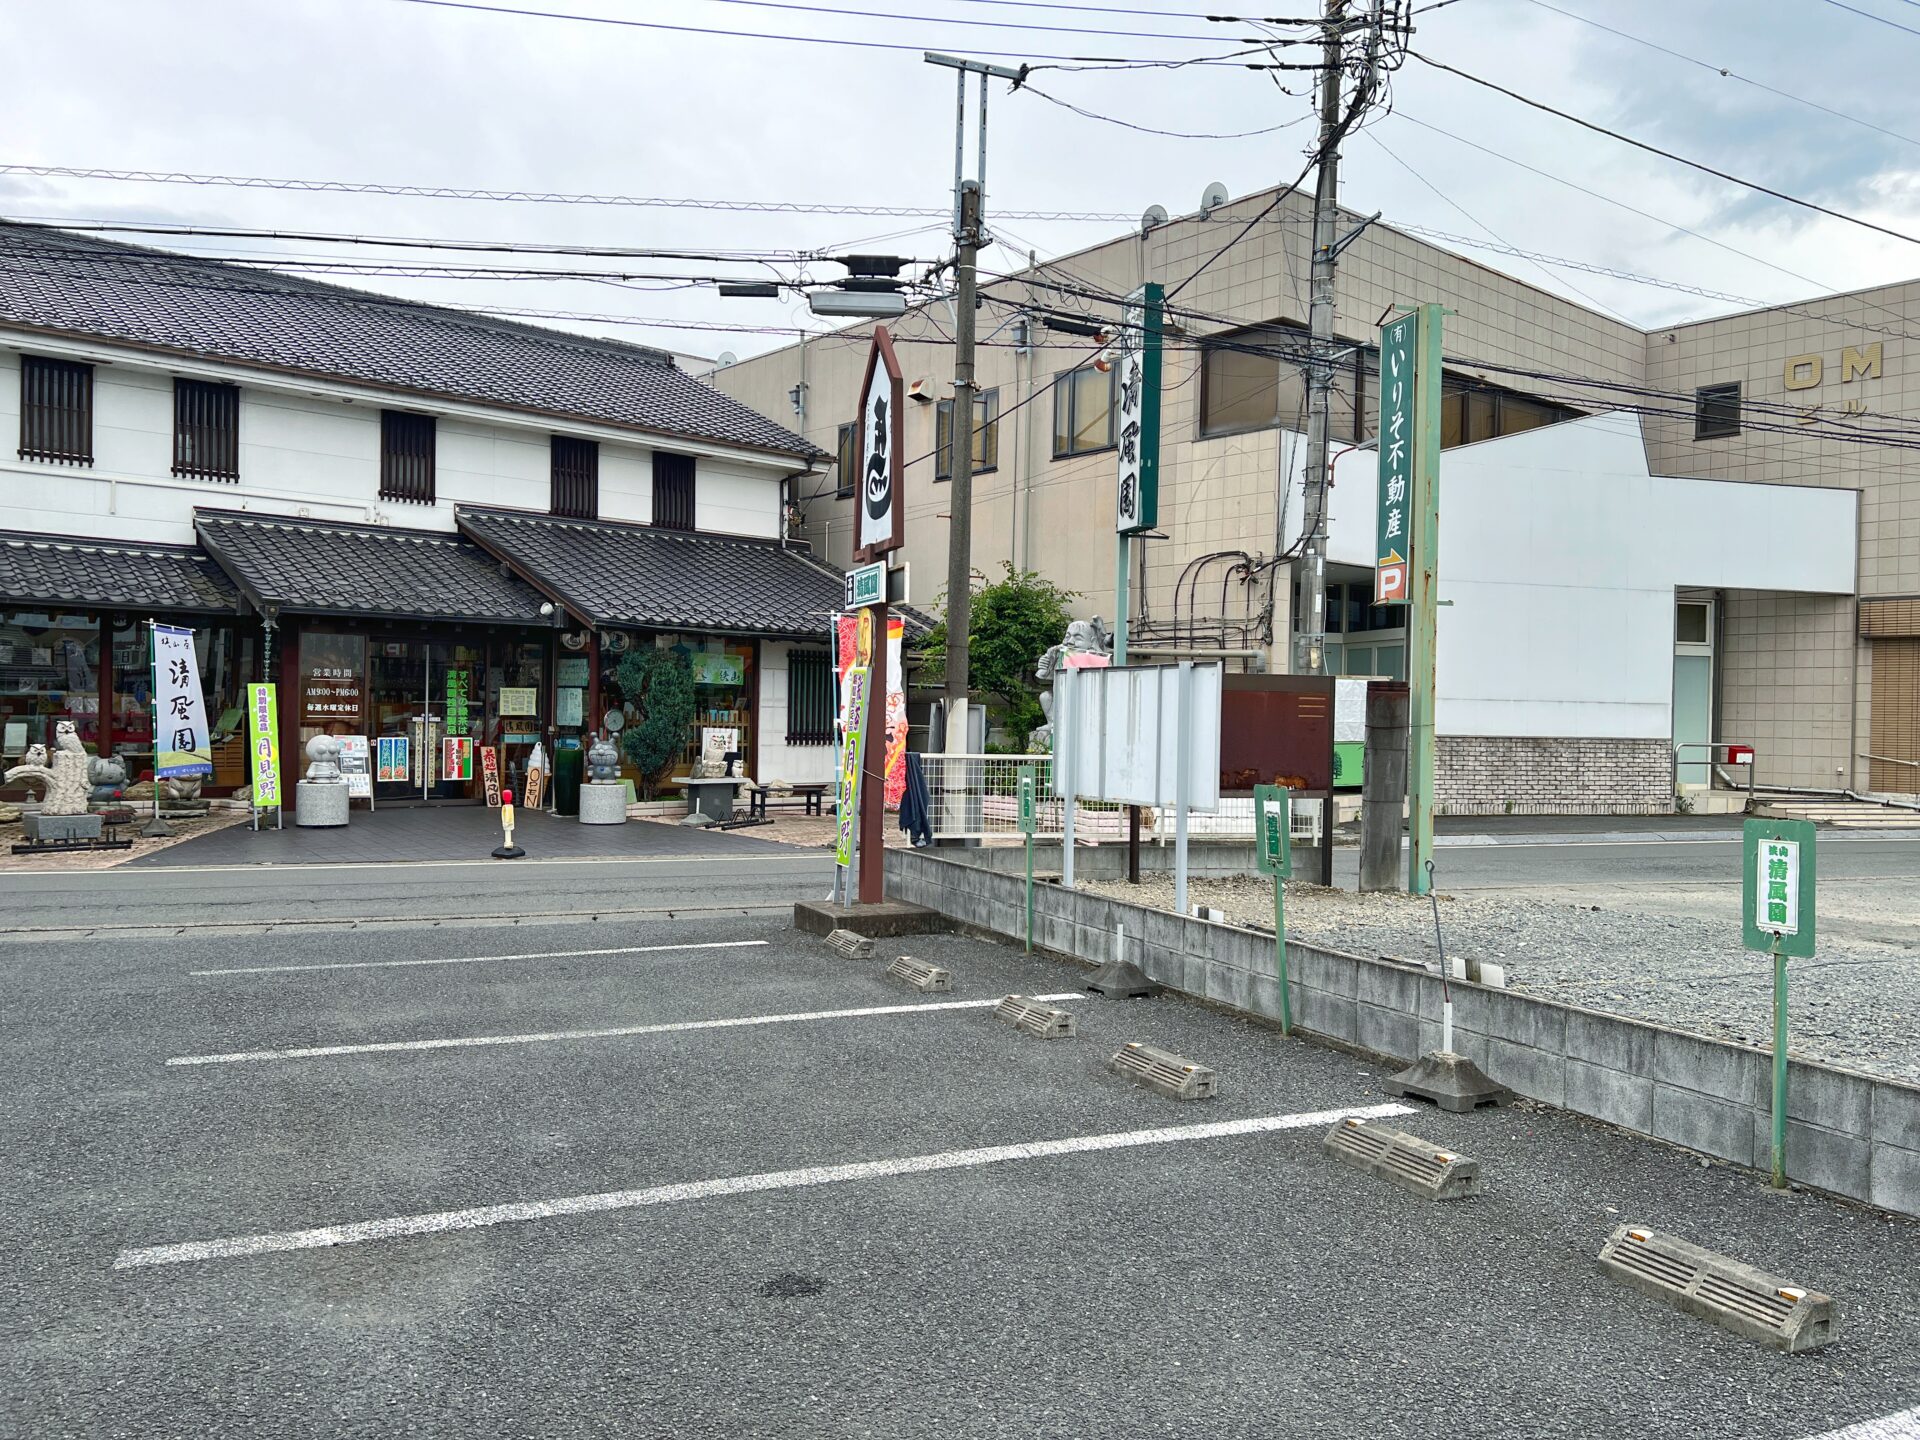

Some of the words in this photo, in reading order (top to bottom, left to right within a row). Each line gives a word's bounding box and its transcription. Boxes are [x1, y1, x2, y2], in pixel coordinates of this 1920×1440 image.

[1380, 569, 1401, 598] P
[312, 668, 352, 678] 営業時間
[169, 658, 195, 753] 清風園
[257, 687, 268, 732] 特別限定品
[307, 703, 359, 712] 毎週水曜定休日
[457, 670, 469, 734] すべての緑茶は
[258, 738, 276, 800] 月見野
[525, 768, 540, 807] OPEN
[840, 740, 856, 856] 月見野
[1767, 858, 1789, 924] 清風園
